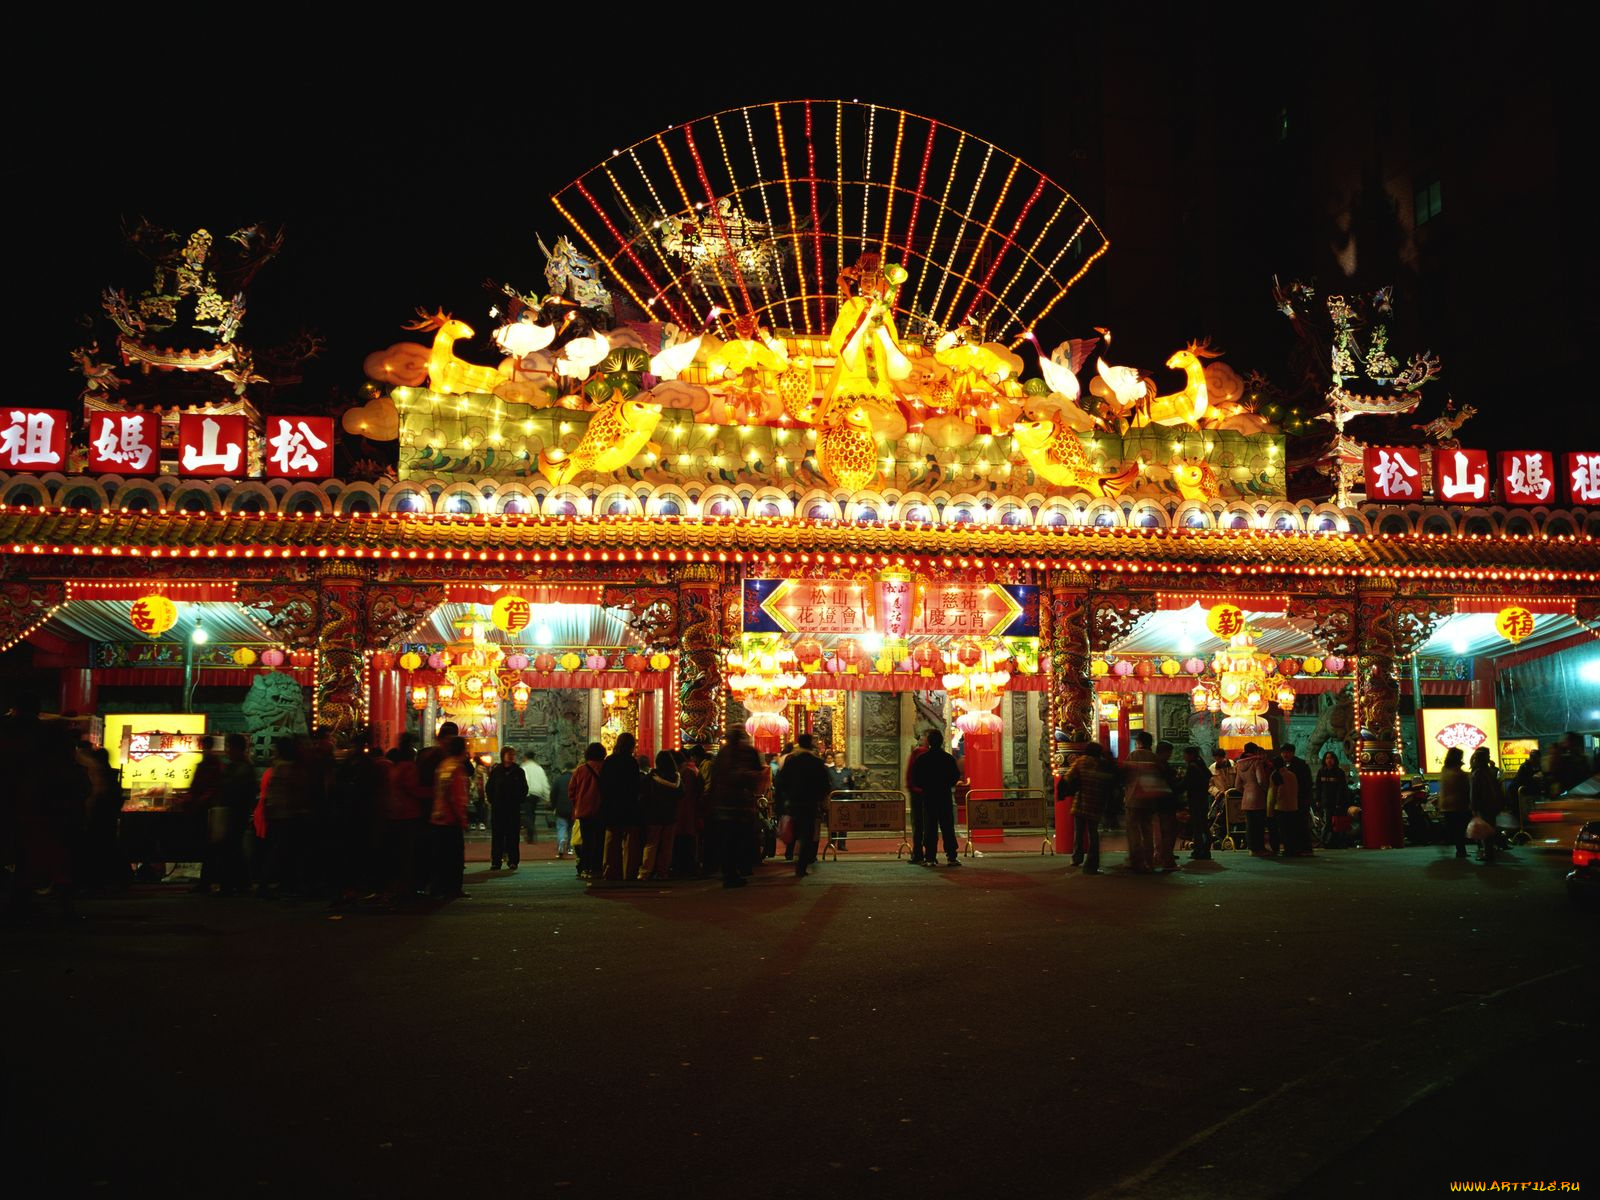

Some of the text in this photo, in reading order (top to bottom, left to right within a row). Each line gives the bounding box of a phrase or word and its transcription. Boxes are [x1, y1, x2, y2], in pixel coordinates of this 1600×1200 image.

[1, 410, 61, 466] 祖
[93, 415, 153, 469] 媽
[182, 417, 242, 472] 山
[270, 418, 328, 473] 松
[1373, 450, 1418, 496] 松
[1442, 451, 1486, 498] 山
[1507, 453, 1551, 500] 媽
[504, 600, 530, 630] 賀
[810, 587, 848, 606] 松山
[929, 609, 986, 628] 慶元宵
[942, 591, 978, 610] 慈祐
[1215, 609, 1244, 636] 新
